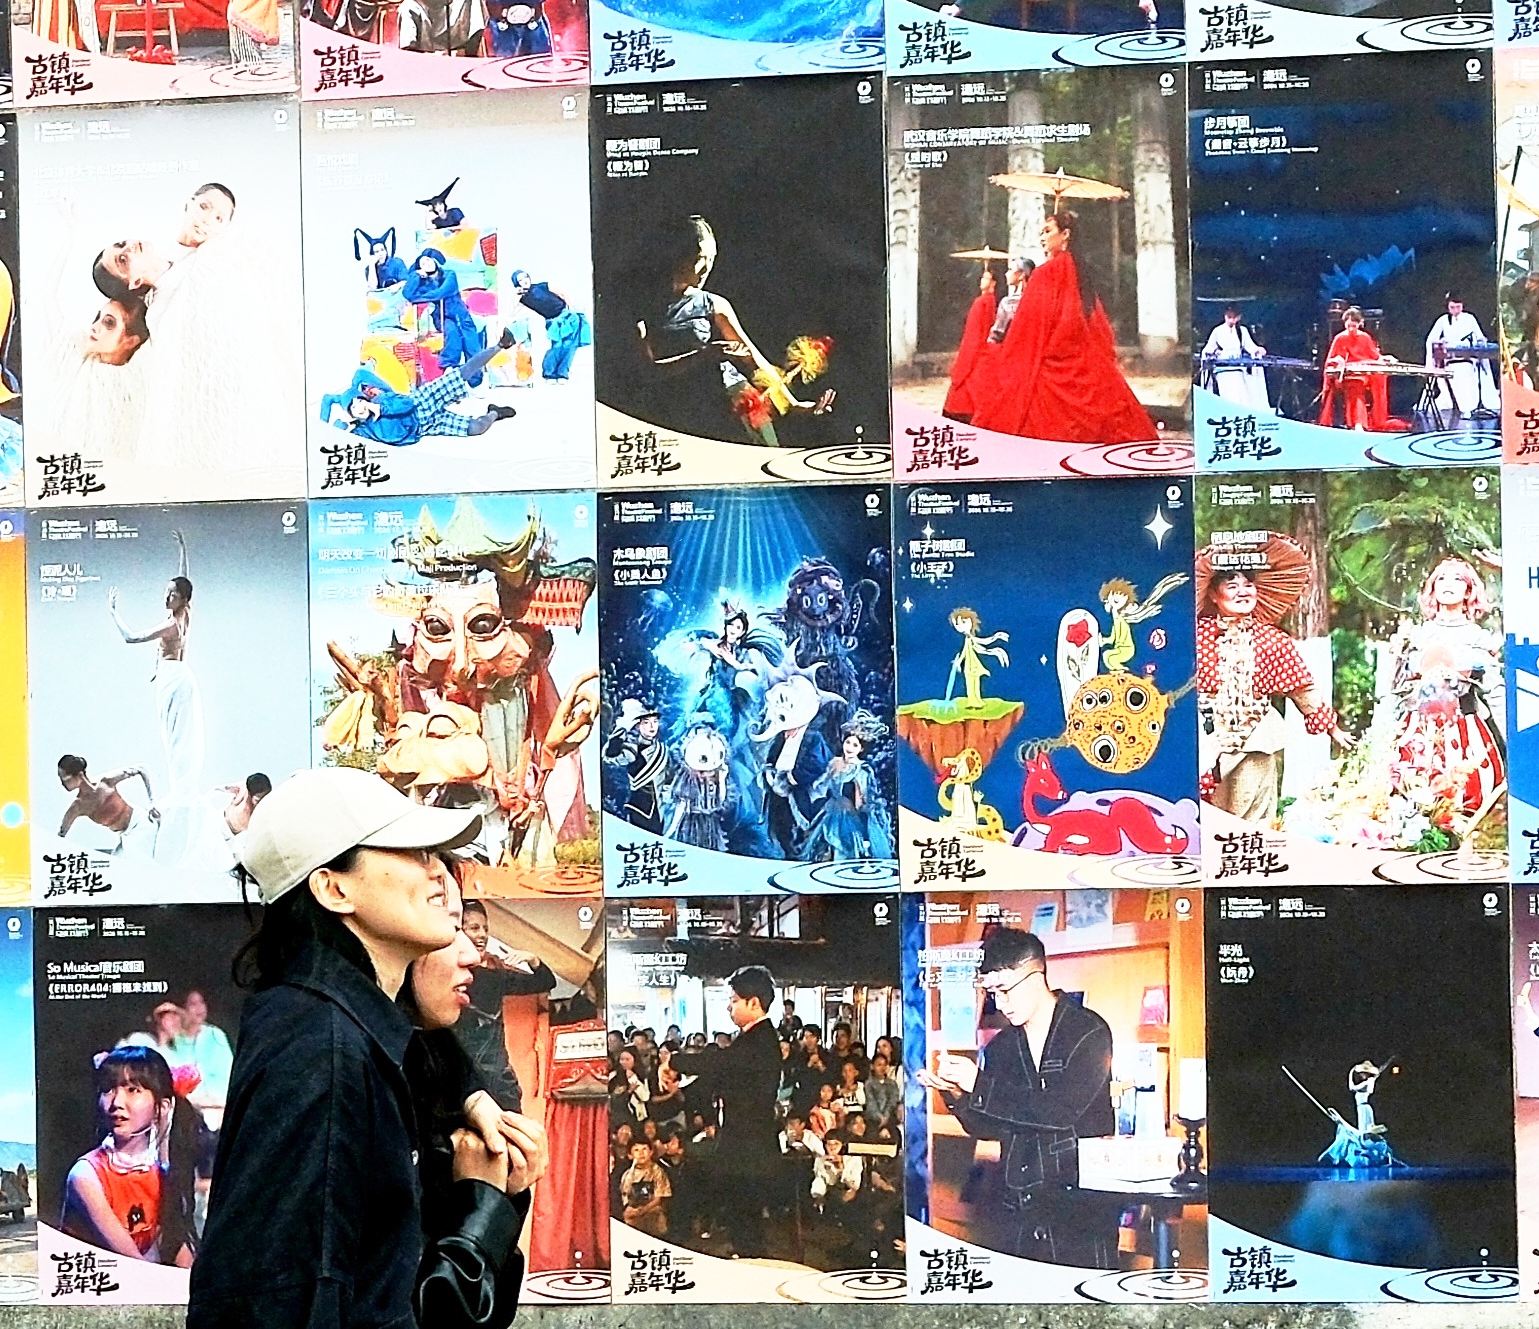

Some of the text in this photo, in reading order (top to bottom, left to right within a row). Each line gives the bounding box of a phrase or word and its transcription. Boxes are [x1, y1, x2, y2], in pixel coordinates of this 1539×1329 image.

[1200, 4, 1248, 28] 古镇
[604, 28, 650, 52] 古镇
[1201, 24, 1274, 52] 嘉年华
[25, 53, 69, 76] 古镇
[605, 48, 674, 76] 嘉年华
[26, 72, 92, 99] 嘉年华
[906, 425, 954, 448] 古镇
[320, 444, 366, 466] 古镇
[907, 445, 980, 472] 嘉年华
[321, 463, 390, 489] 嘉年华
[434, 563, 477, 572] Production
[613, 567, 667, 580] 《小美人鱼》
[910, 561, 954, 574] 《小王子》
[617, 842, 663, 864] 古镇
[1215, 832, 1263, 854] 古镇
[44, 853, 88, 874] 古镇
[1216, 853, 1289, 878] 嘉年华
[45, 873, 111, 897] 嘉年华
[618, 863, 687, 888] 嘉年华
[1219, 945, 1242, 957] 半光
[47, 962, 61, 973] So
[50, 1252, 96, 1273] 古镇
[919, 1248, 967, 1270] 古镇
[51, 1272, 120, 1296] 嘉年华
[920, 1269, 993, 1294] 嘉年华
